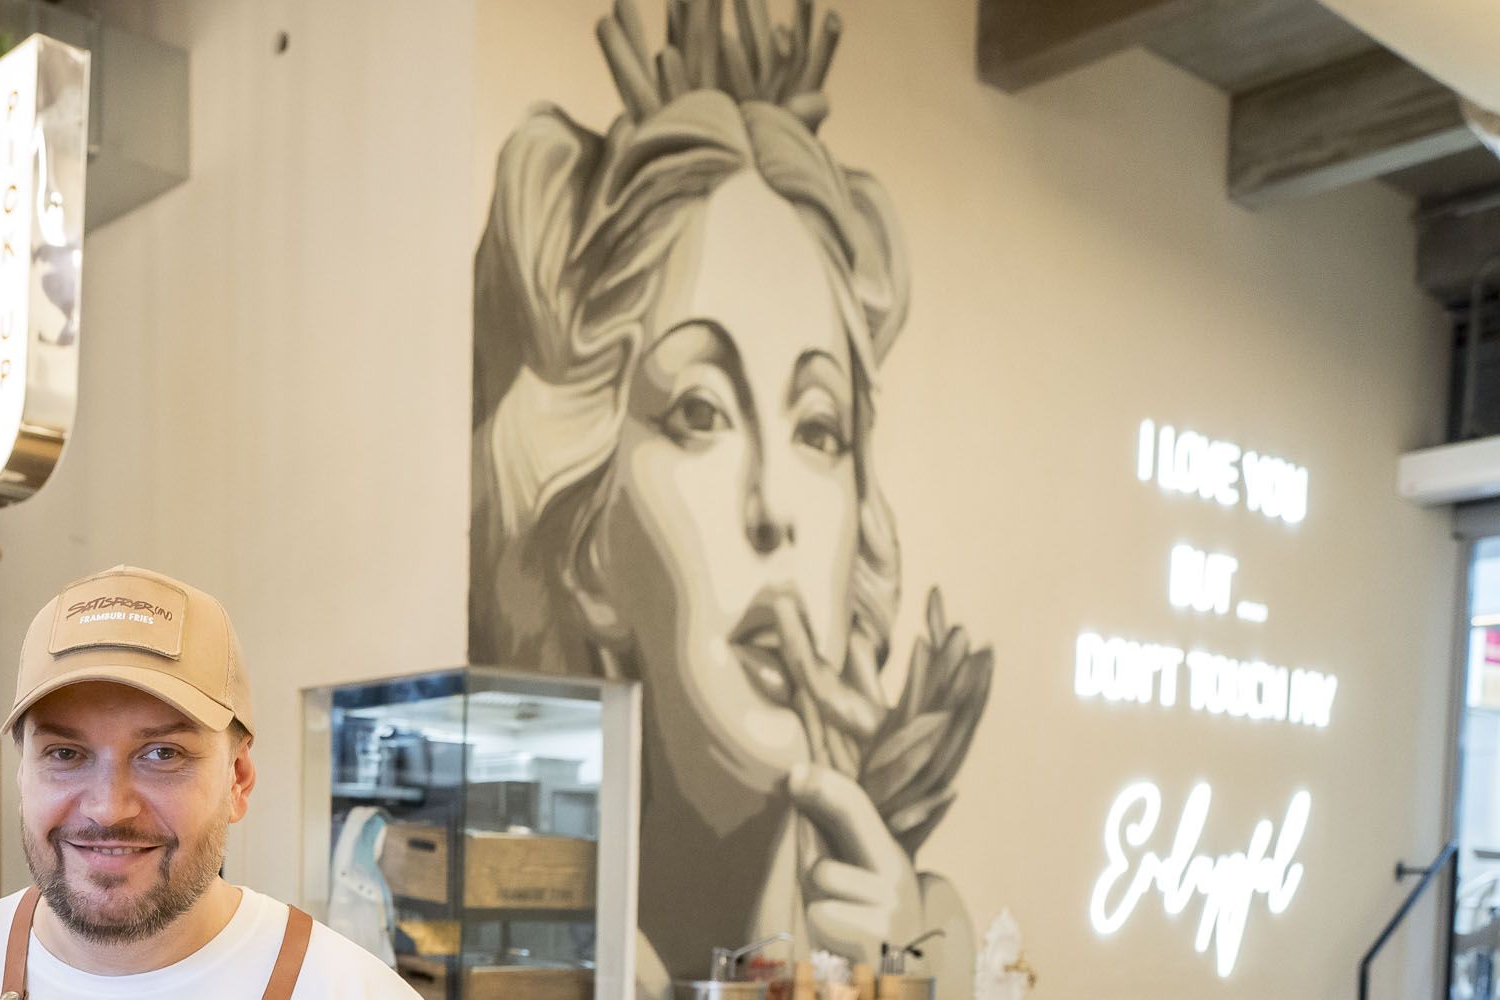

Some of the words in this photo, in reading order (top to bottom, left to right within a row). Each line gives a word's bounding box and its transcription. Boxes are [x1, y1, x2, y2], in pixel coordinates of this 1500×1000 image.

[1137, 417, 1156, 482] I
[1157, 424, 1242, 506] LOVE
[1242, 450, 1309, 524] YOU
[80, 611, 126, 625] FRAMBURI
[128, 611, 155, 625] FRIES
[1073, 631, 1185, 707] DON'T
[1185, 649, 1289, 722] TOUCH
[1288, 667, 1339, 729] MY
